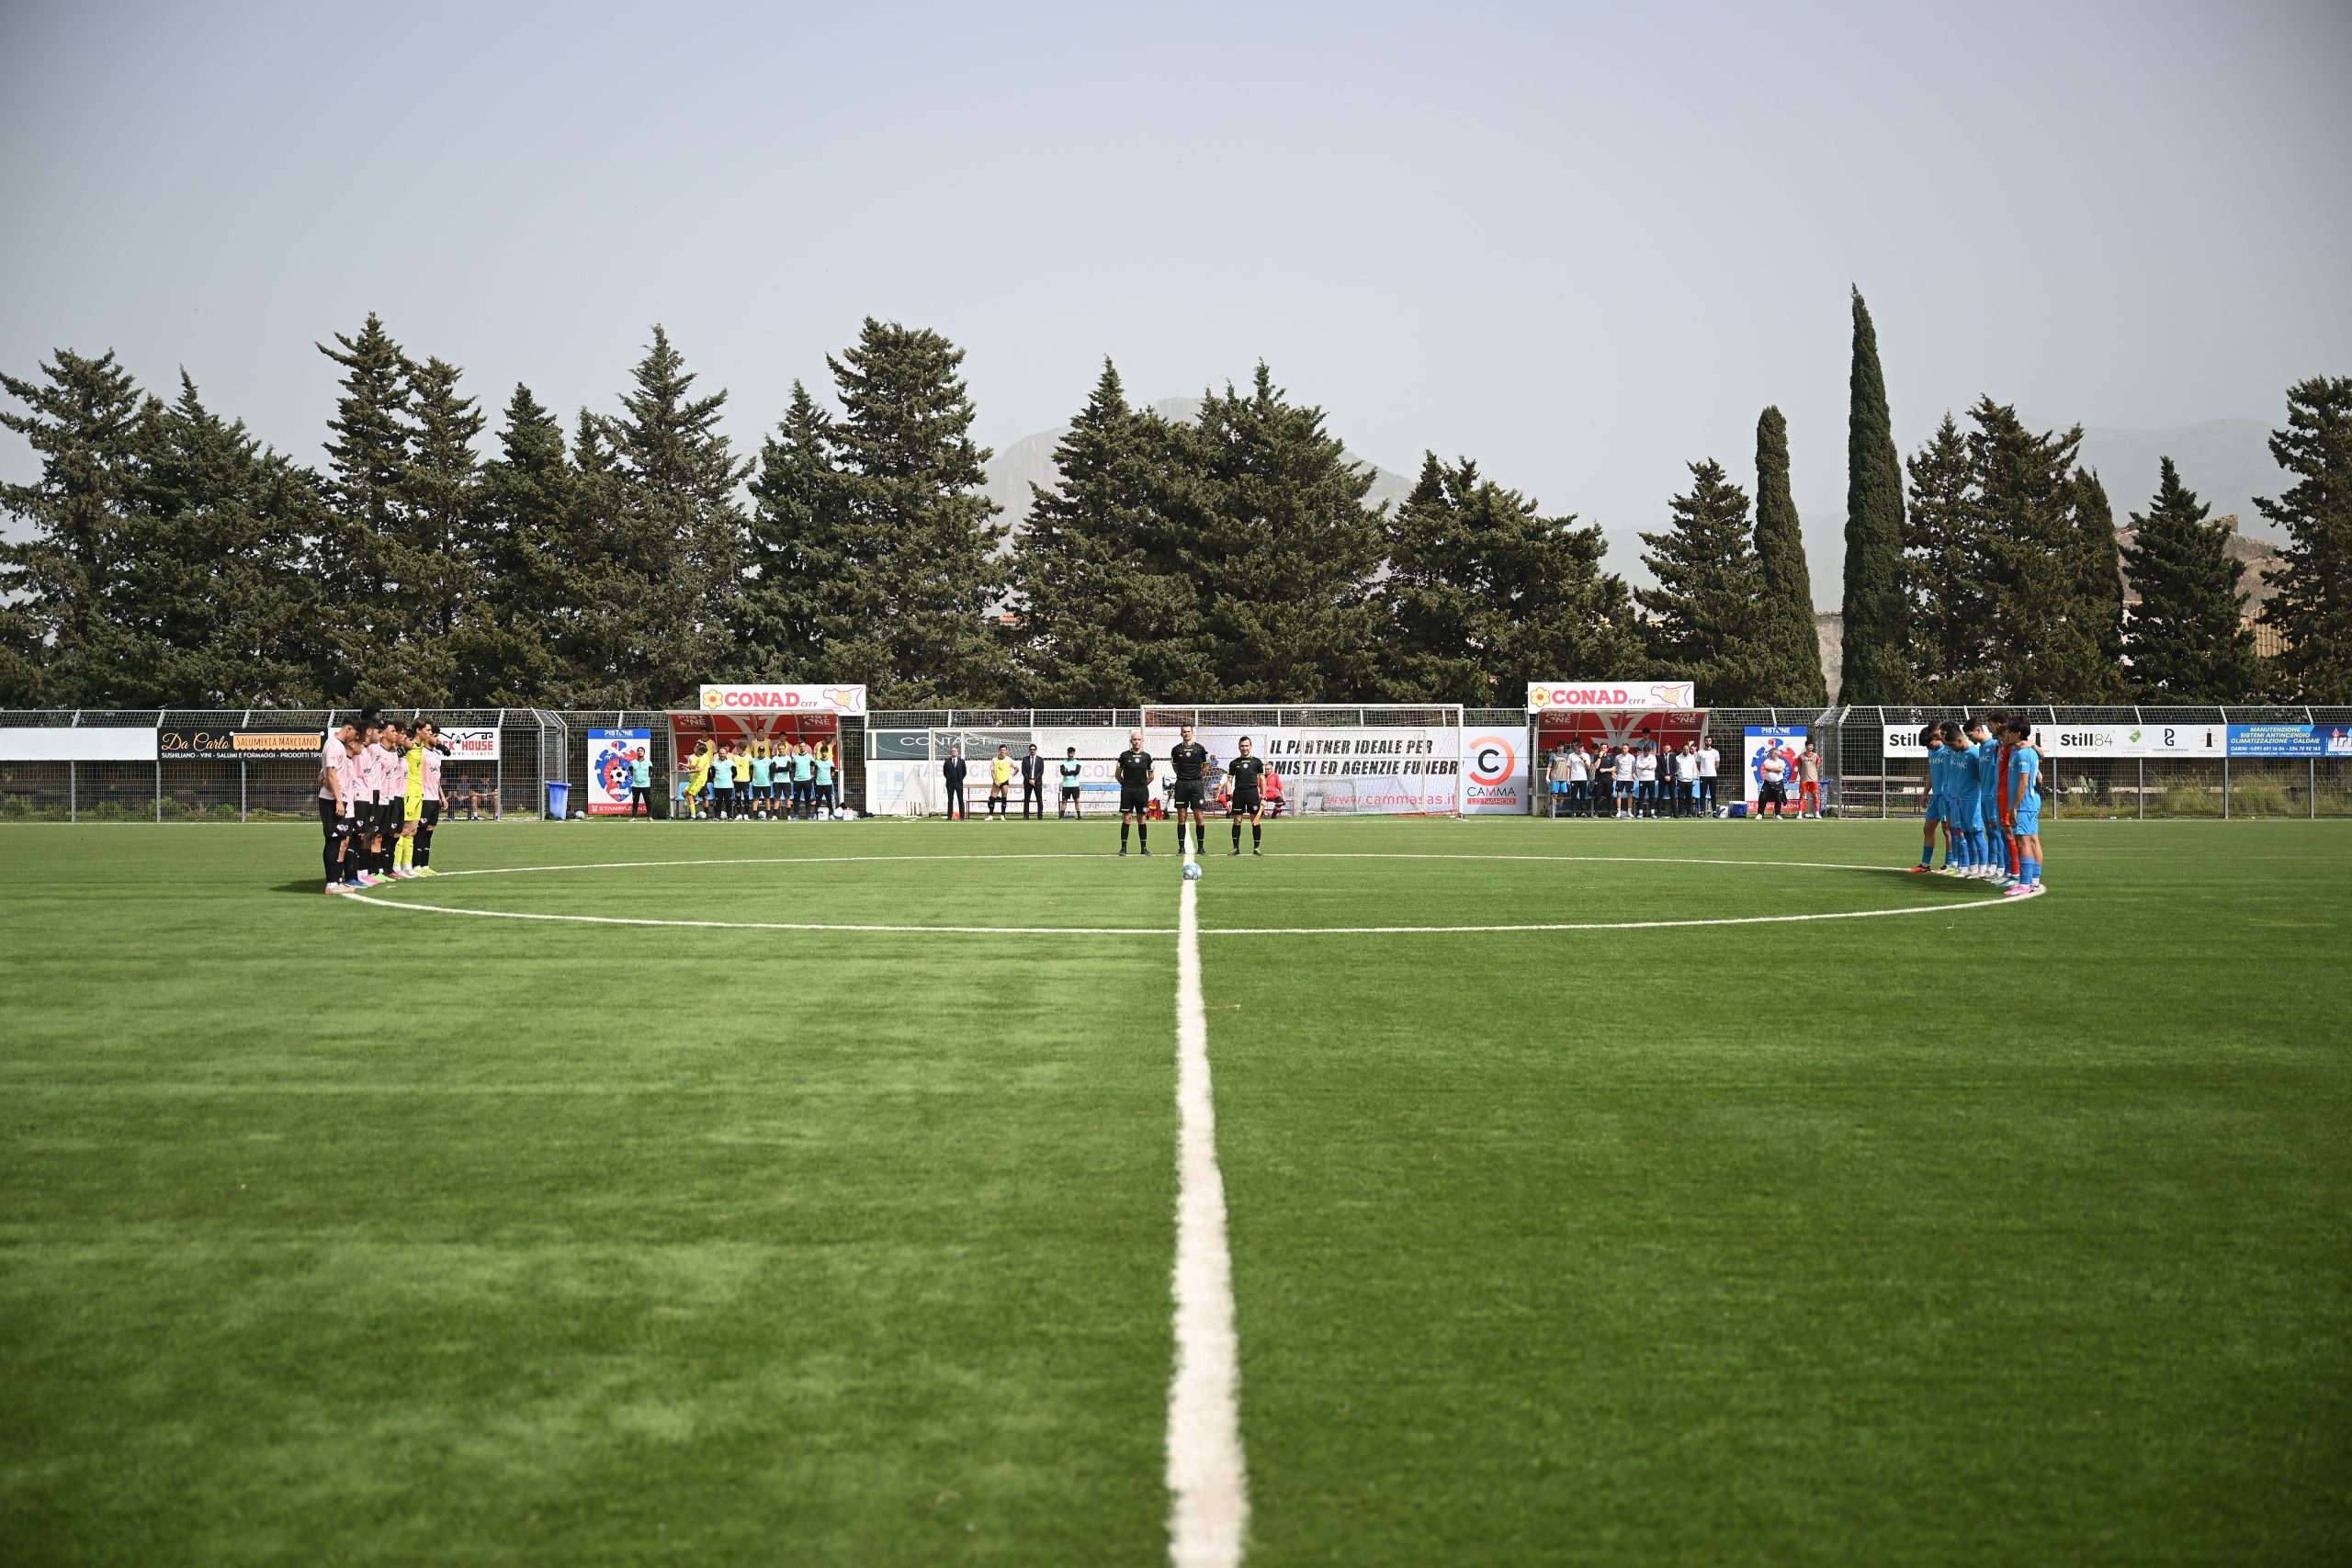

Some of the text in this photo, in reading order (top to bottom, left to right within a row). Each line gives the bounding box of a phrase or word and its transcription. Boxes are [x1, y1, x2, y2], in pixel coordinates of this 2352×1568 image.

[724, 693, 800, 707] CONAD
[1552, 690, 1628, 705] CONAD
[161, 732, 189, 750] Da
[193, 732, 231, 751] Carlo
[236, 737, 277, 747] SALUMERIA
[461, 740, 493, 750] HOUSE
[900, 737, 987, 746] CONTACT
[1270, 739, 1433, 754] IL PARTNER IDEALE PER
[2061, 733, 2113, 747] Still84
[1320, 761, 1339, 775] ED
[1340, 761, 1400, 775] AGENZIE
[1467, 786, 1516, 797] CAMMA
